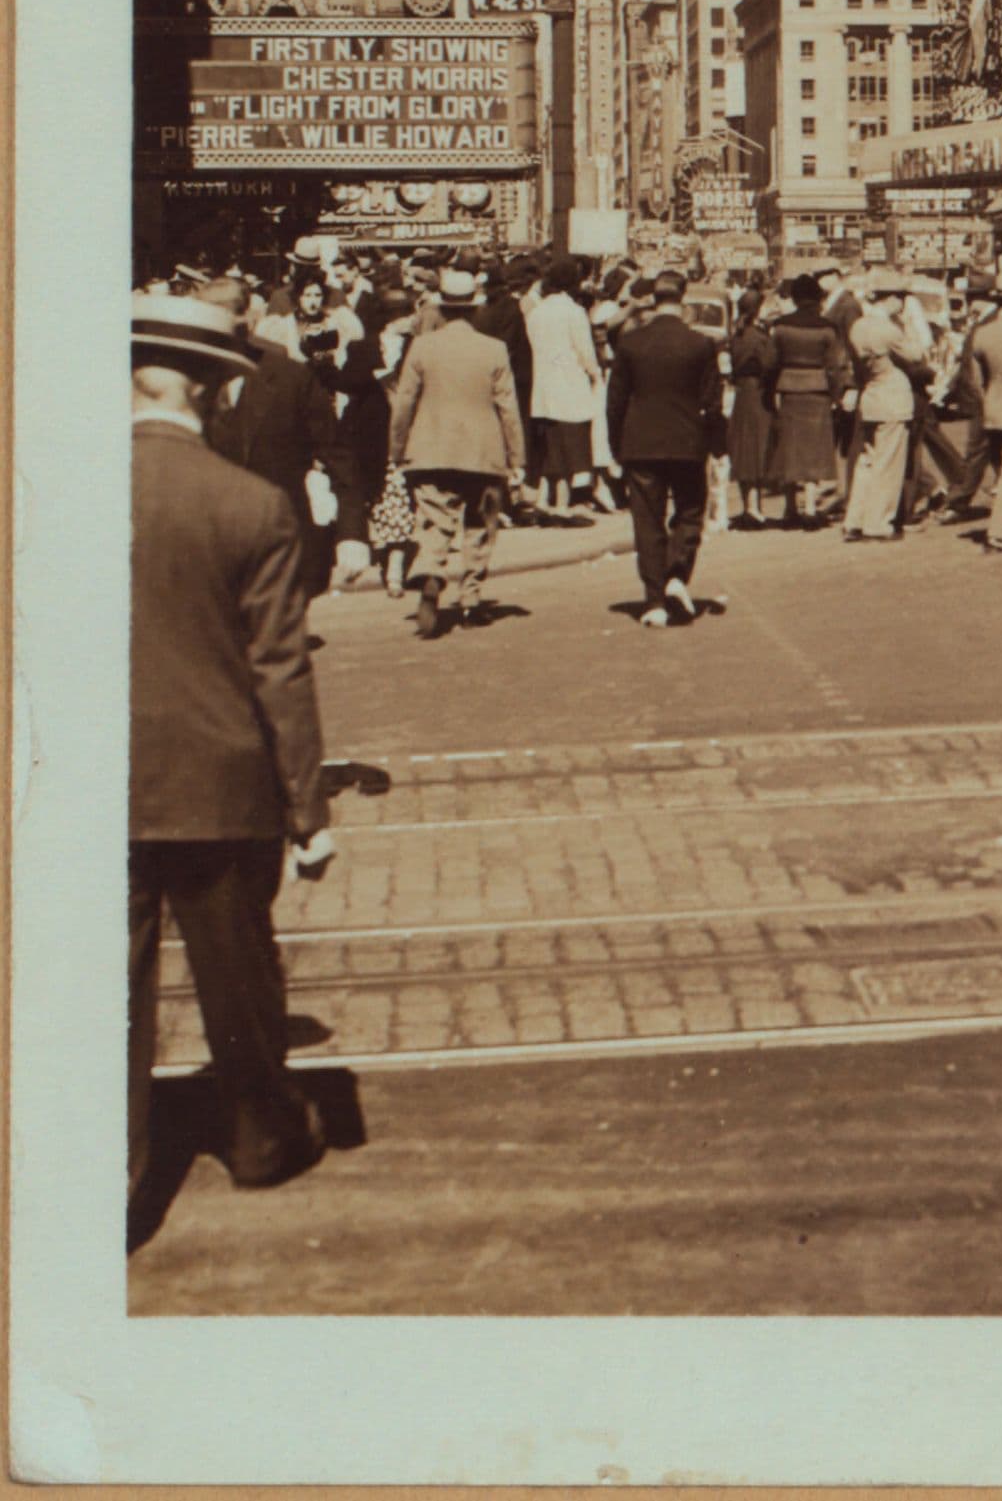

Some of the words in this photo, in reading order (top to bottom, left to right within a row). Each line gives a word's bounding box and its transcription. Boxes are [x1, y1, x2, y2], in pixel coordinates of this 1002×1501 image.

[250, 37, 326, 61] FIRST
[335, 37, 384, 61] N.Y.
[391, 37, 509, 61] SHOWING
[283, 67, 405, 91] CHESTER
[411, 67, 509, 91] MORRIS
[212, 96, 320, 119] "FLIGHT
[328, 96, 400, 119] FROM
[408, 96, 510, 120] GLORY"
[145, 125, 268, 149] "PIERRE"
[301, 125, 389, 149] WILLIE
[396, 125, 510, 149] HOWARD
